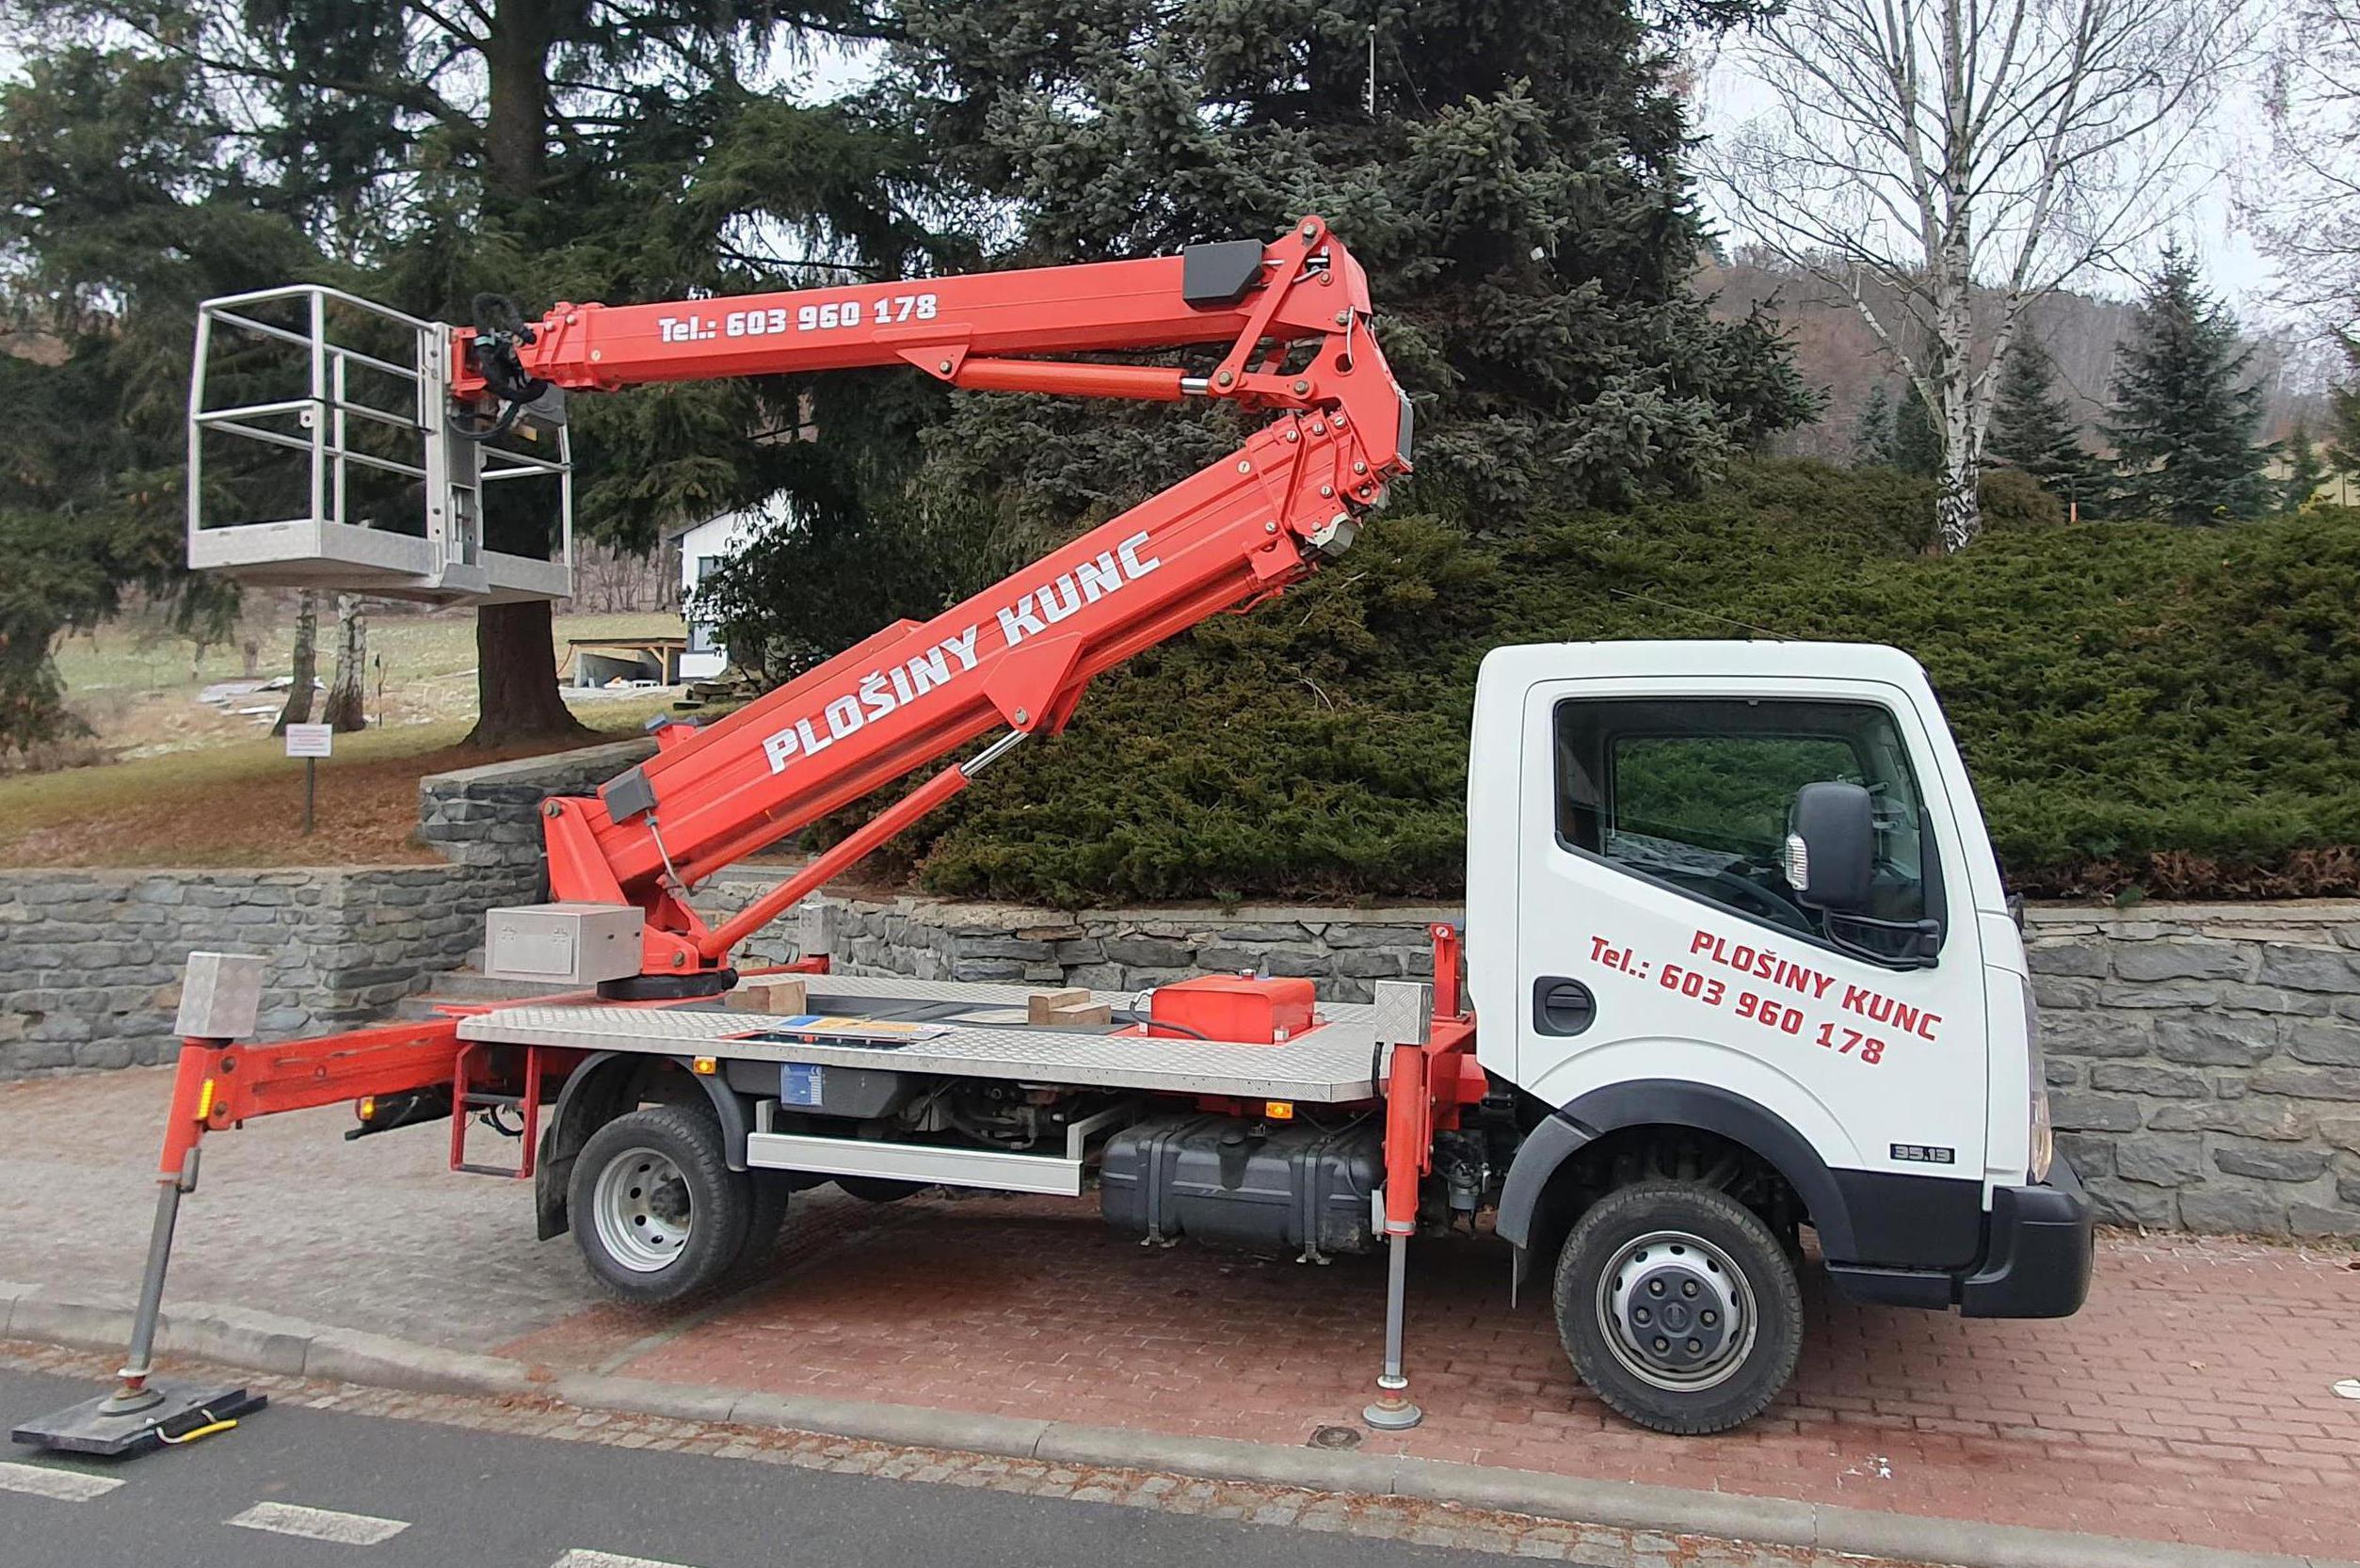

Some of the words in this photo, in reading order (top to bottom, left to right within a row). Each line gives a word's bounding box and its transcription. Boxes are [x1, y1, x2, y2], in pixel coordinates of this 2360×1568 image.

[658, 316, 716, 343] Tel.:
[726, 308, 787, 337] 603
[797, 301, 861, 331] 960
[873, 294, 938, 324] 178
[762, 624, 979, 775] PLOŠINY
[995, 530, 1162, 648] KUNC
[1589, 936, 1650, 980] Tel.:
[1660, 964, 1726, 1006] 603
[1734, 991, 1805, 1034] 960
[1816, 1022, 1886, 1065] 178
[1690, 930, 1837, 1000] PLOŠINY
[1841, 984, 1942, 1041] KUNC
[1894, 1144, 1951, 1162] 35.13
